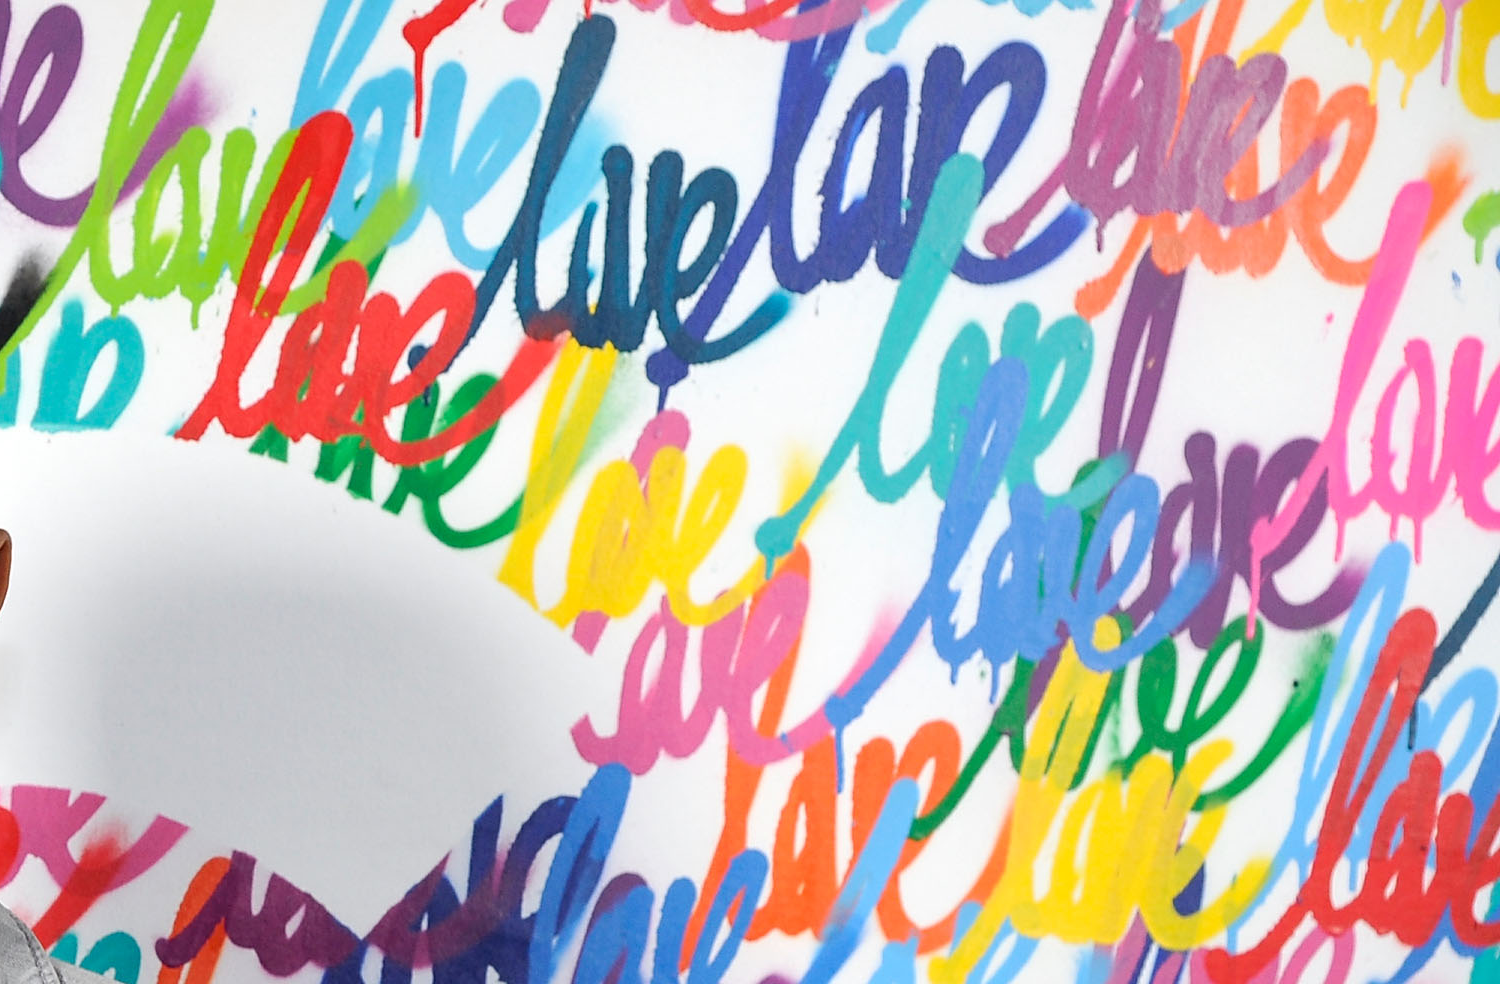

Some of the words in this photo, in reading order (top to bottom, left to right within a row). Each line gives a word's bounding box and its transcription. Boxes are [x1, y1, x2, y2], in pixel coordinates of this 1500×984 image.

[172, 110, 580, 467] love
[240, 0, 618, 270] love
[407, 13, 790, 378] love
[645, 0, 1092, 390] love
[983, 0, 1332, 256] love
[498, 333, 832, 631] love
[753, 152, 1132, 560] love
[825, 355, 1220, 725] love
[676, 540, 1025, 972] love
[928, 612, 1272, 984] love
